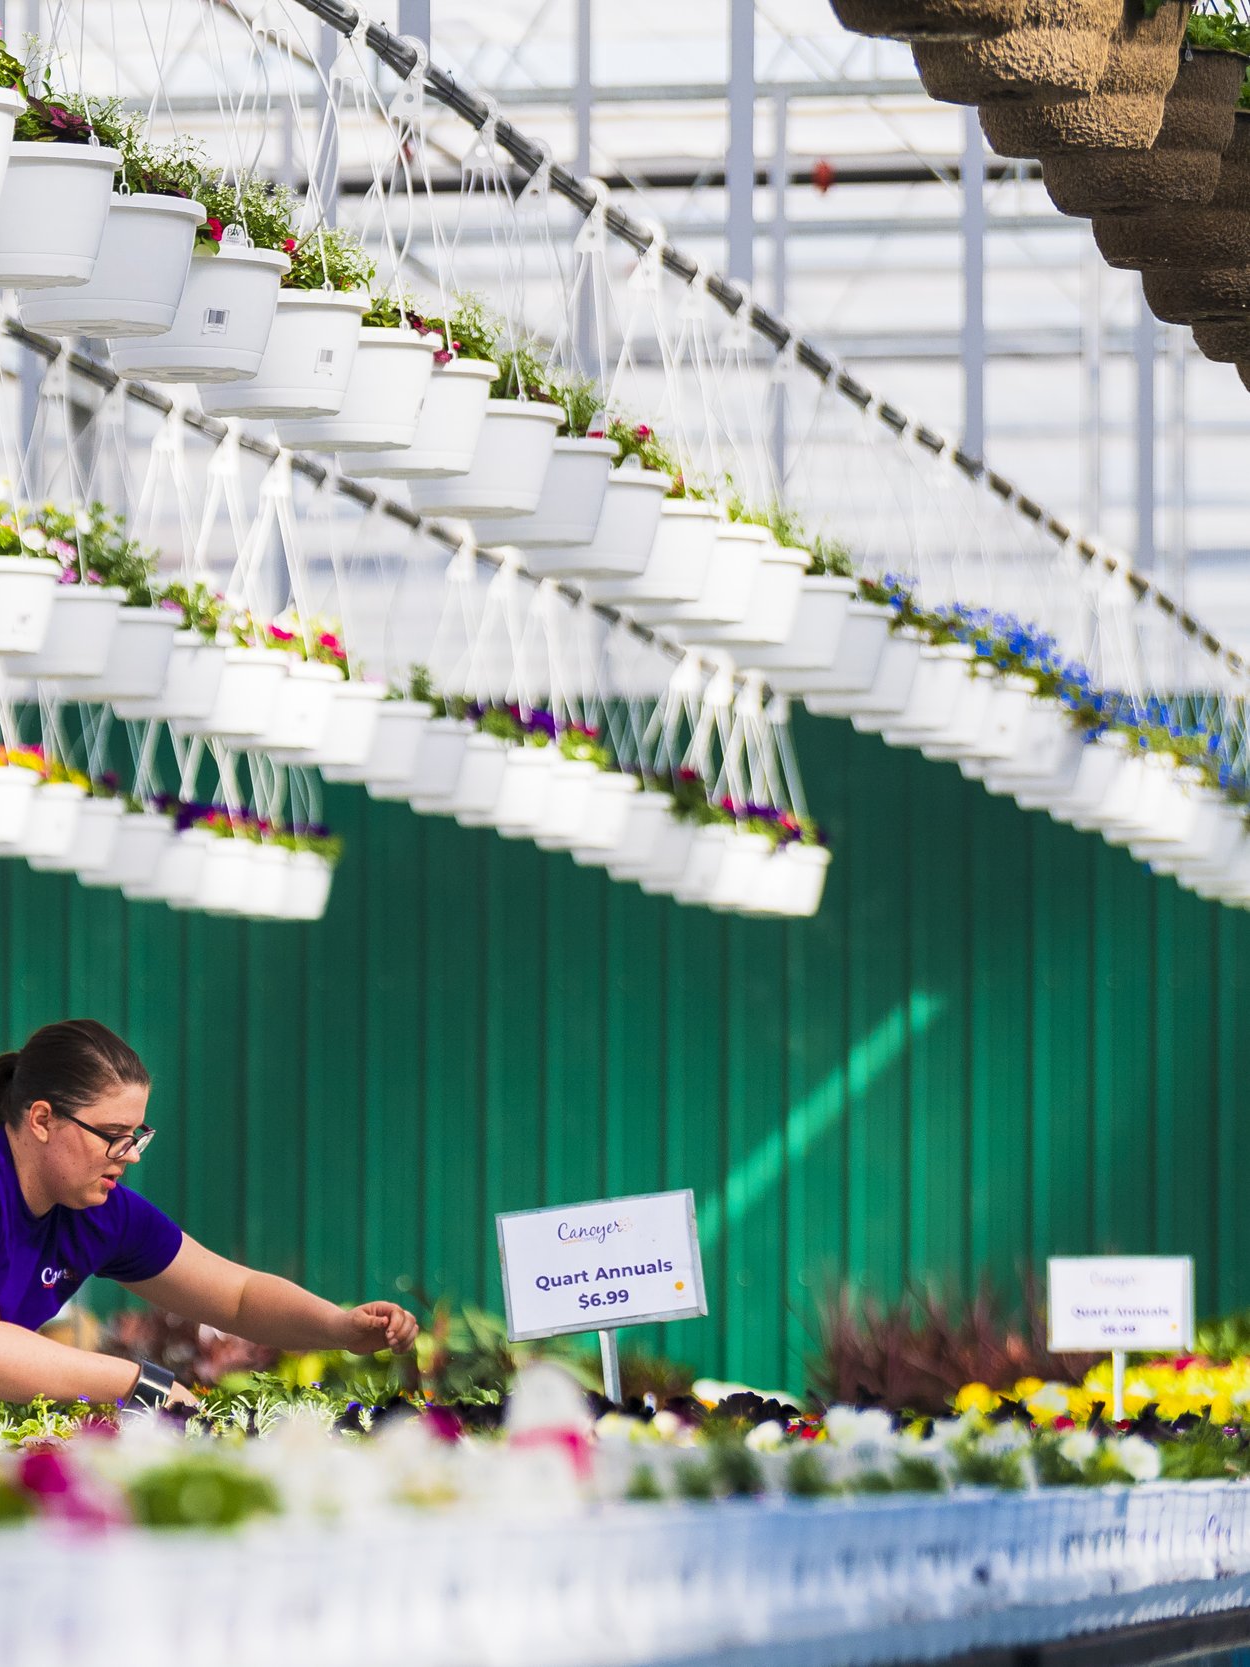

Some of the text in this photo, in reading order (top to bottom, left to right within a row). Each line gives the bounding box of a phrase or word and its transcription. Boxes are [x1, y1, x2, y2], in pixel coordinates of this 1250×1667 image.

[557, 1220, 622, 1243] Canoyer
[535, 1259, 673, 1292] Quart Annuals
[578, 1289, 630, 1310] $6.99
